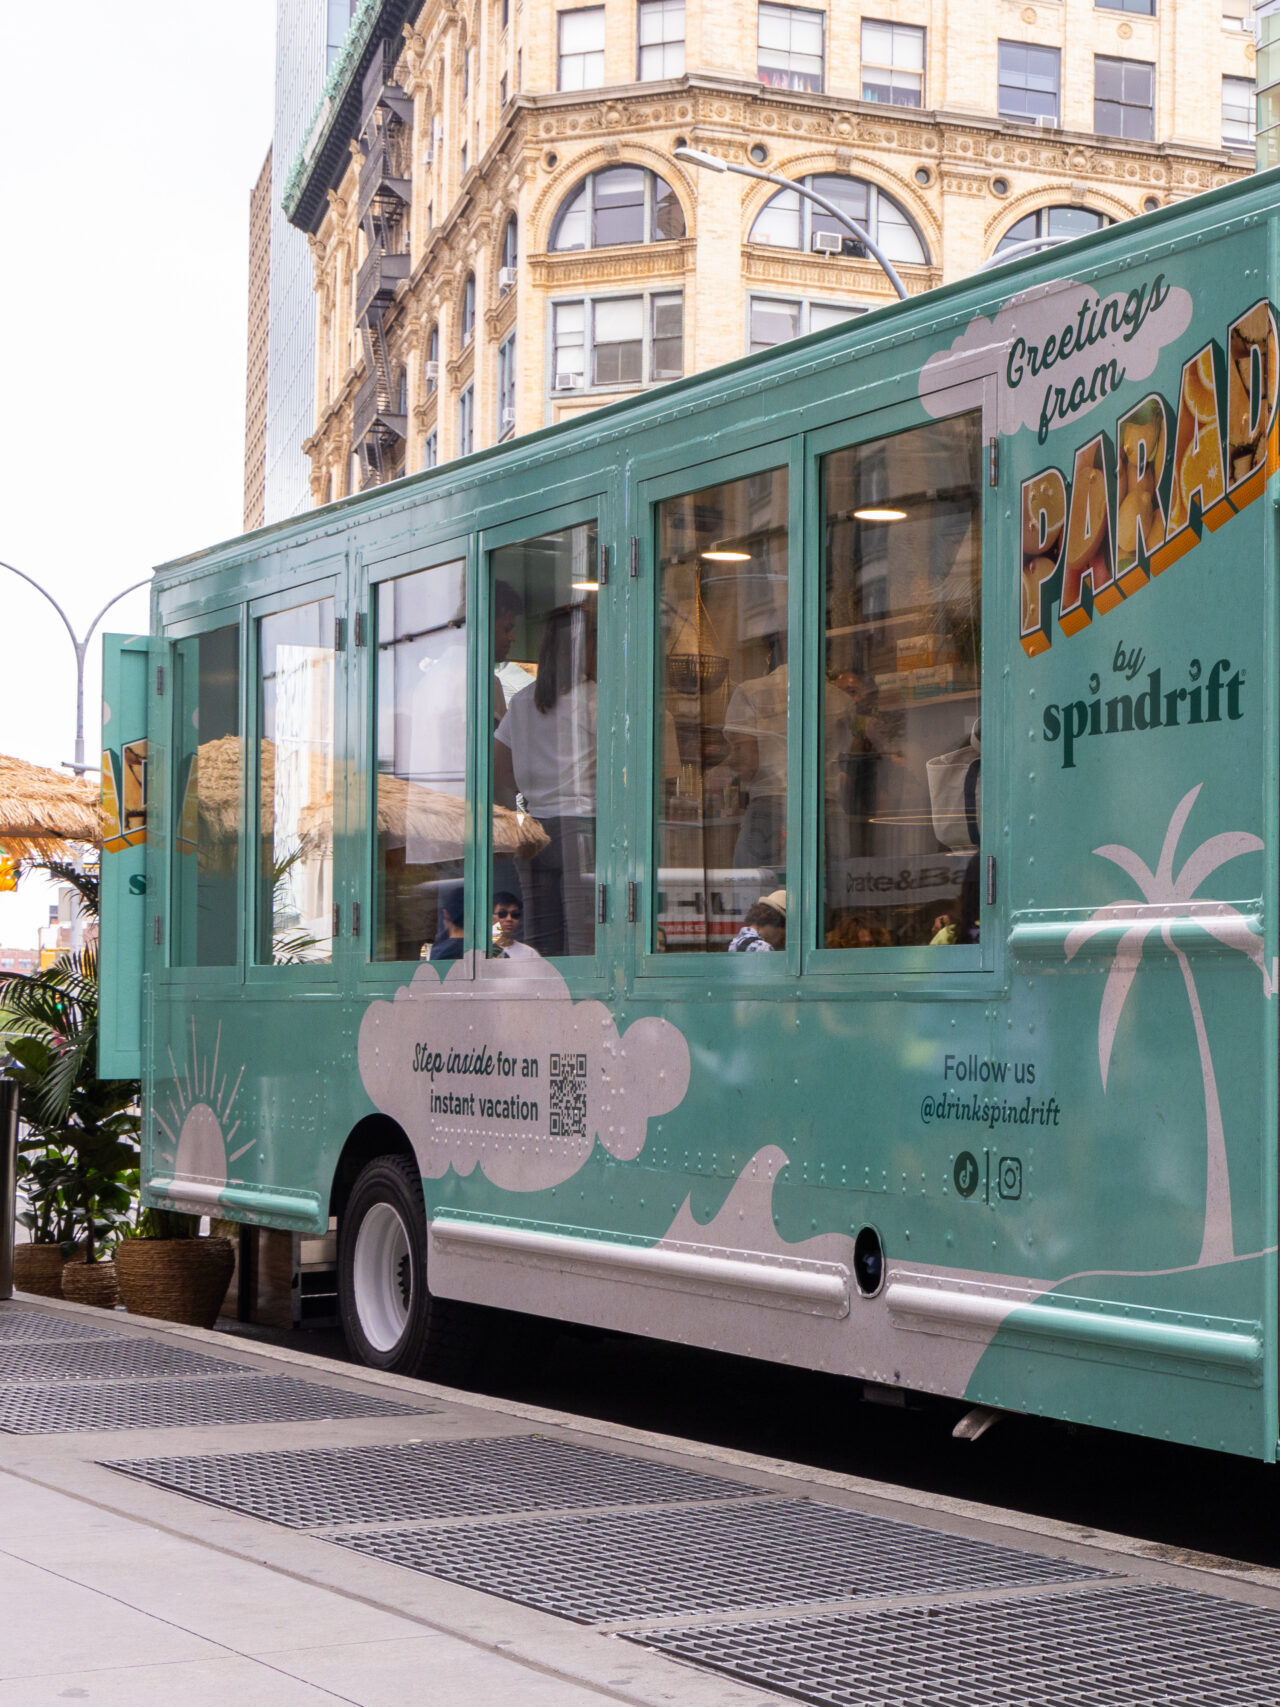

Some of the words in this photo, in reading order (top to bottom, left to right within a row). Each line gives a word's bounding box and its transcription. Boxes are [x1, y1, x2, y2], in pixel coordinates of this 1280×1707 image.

[1007, 273, 1170, 388] Greetings
[1038, 358, 1126, 445] from
[1113, 640, 1146, 681] by
[413, 1042, 445, 1082] Step
[447, 1044, 495, 1076] inside
[497, 1051, 518, 1077] for
[521, 1057, 539, 1078] an
[944, 1054, 1008, 1082] Follow
[1014, 1063, 1035, 1084] us
[430, 1088, 475, 1117] instant
[479, 1094, 539, 1121] vacation
[921, 1092, 1061, 1129] @drinkspindrift
